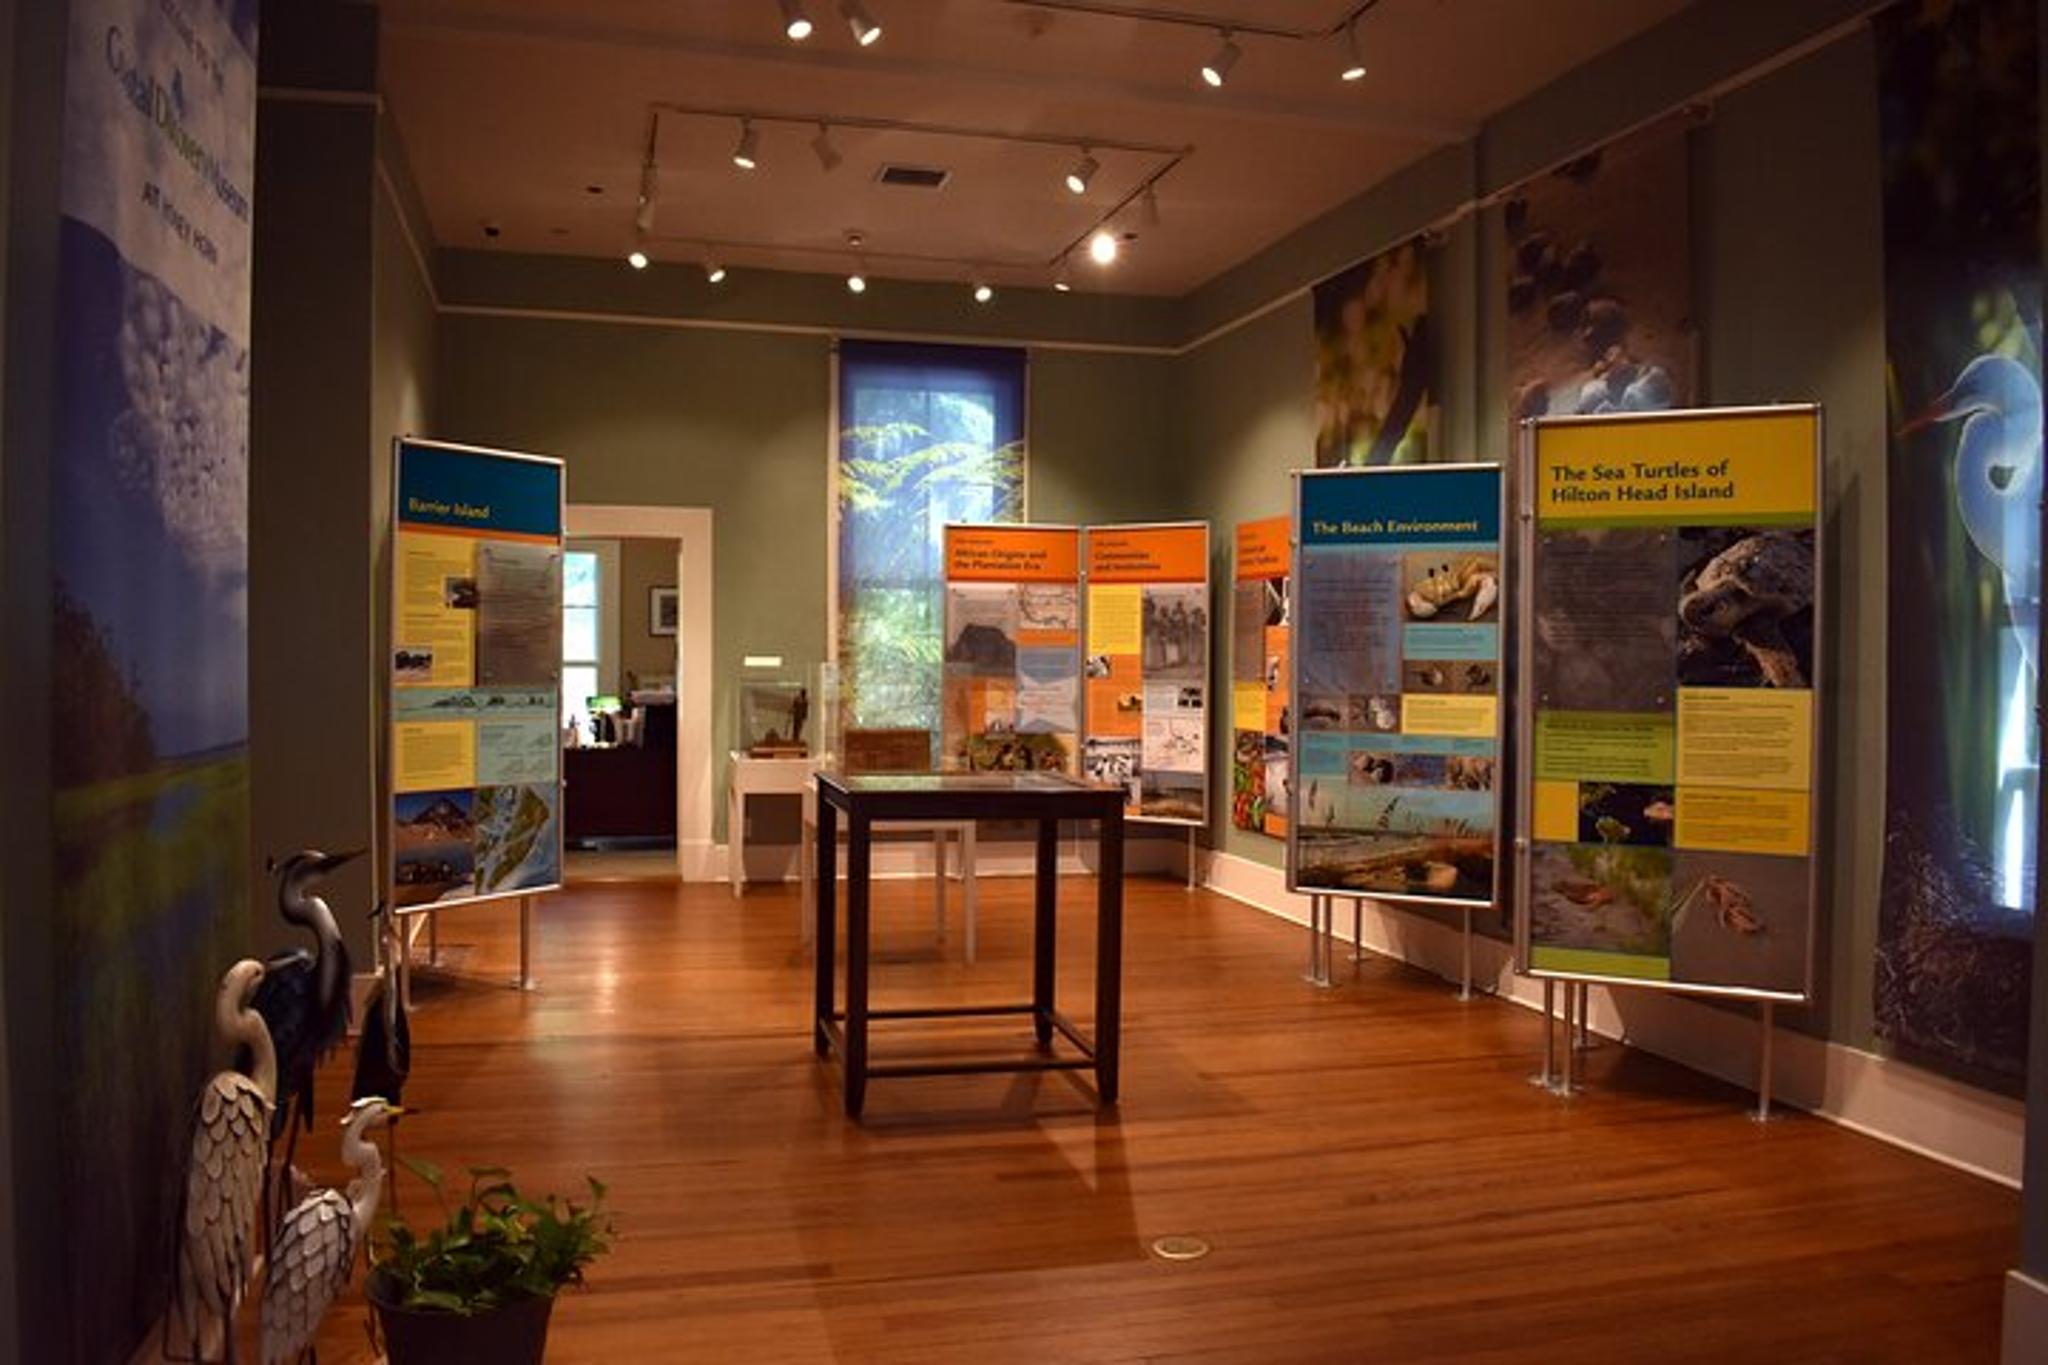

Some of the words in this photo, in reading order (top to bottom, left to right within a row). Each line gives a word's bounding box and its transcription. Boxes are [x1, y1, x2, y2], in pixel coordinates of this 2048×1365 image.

[1551, 465, 1587, 481] The
[1592, 464, 1625, 480] Sea
[1632, 461, 1700, 479] Turtles
[1706, 459, 1730, 476] of
[1551, 486, 1611, 503] Hilton
[1616, 484, 1668, 501] Head
[1674, 482, 1735, 499] Island
[454, 501, 490, 519] Island
[1312, 520, 1338, 534] The
[1341, 519, 1383, 534] Beach
[1387, 519, 1479, 533] Environment
